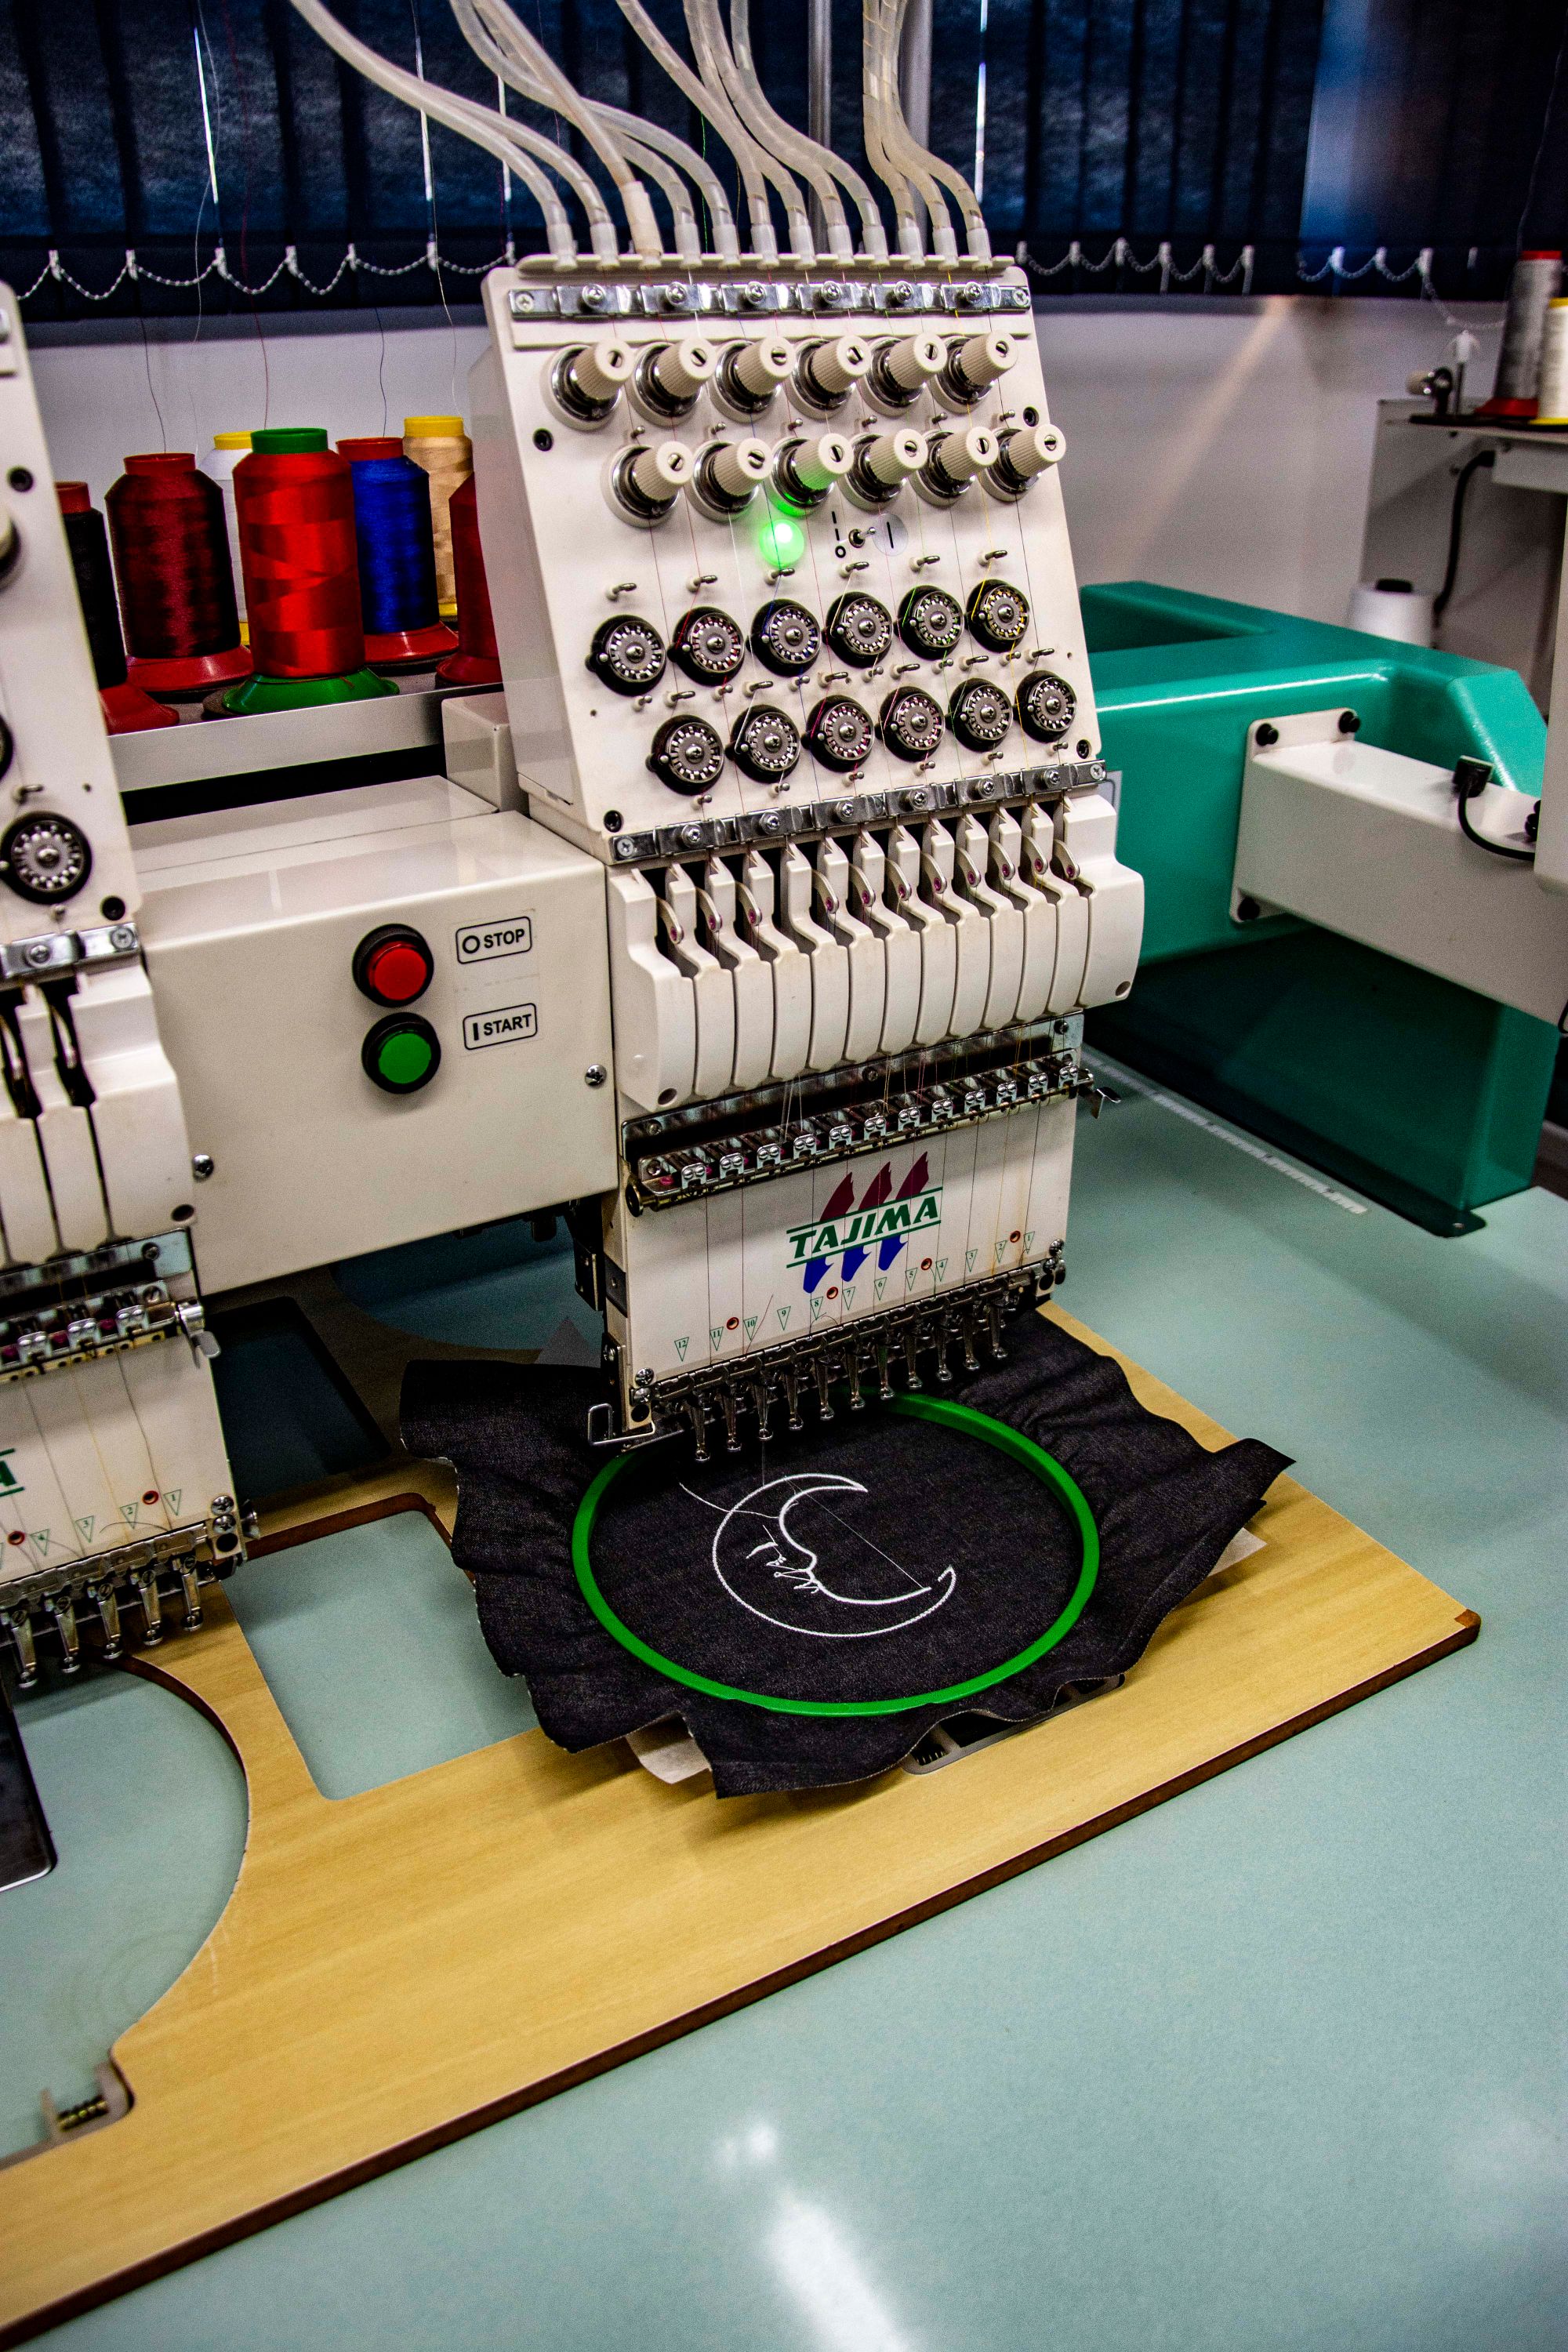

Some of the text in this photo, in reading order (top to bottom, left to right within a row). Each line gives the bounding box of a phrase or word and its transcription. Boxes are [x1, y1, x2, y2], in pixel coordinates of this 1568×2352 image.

[484, 928, 524, 949] STOP
[483, 1014, 532, 1036] START
[789, 1196, 938, 1258] TAJIMA
[677, 1340, 687, 1348] 12
